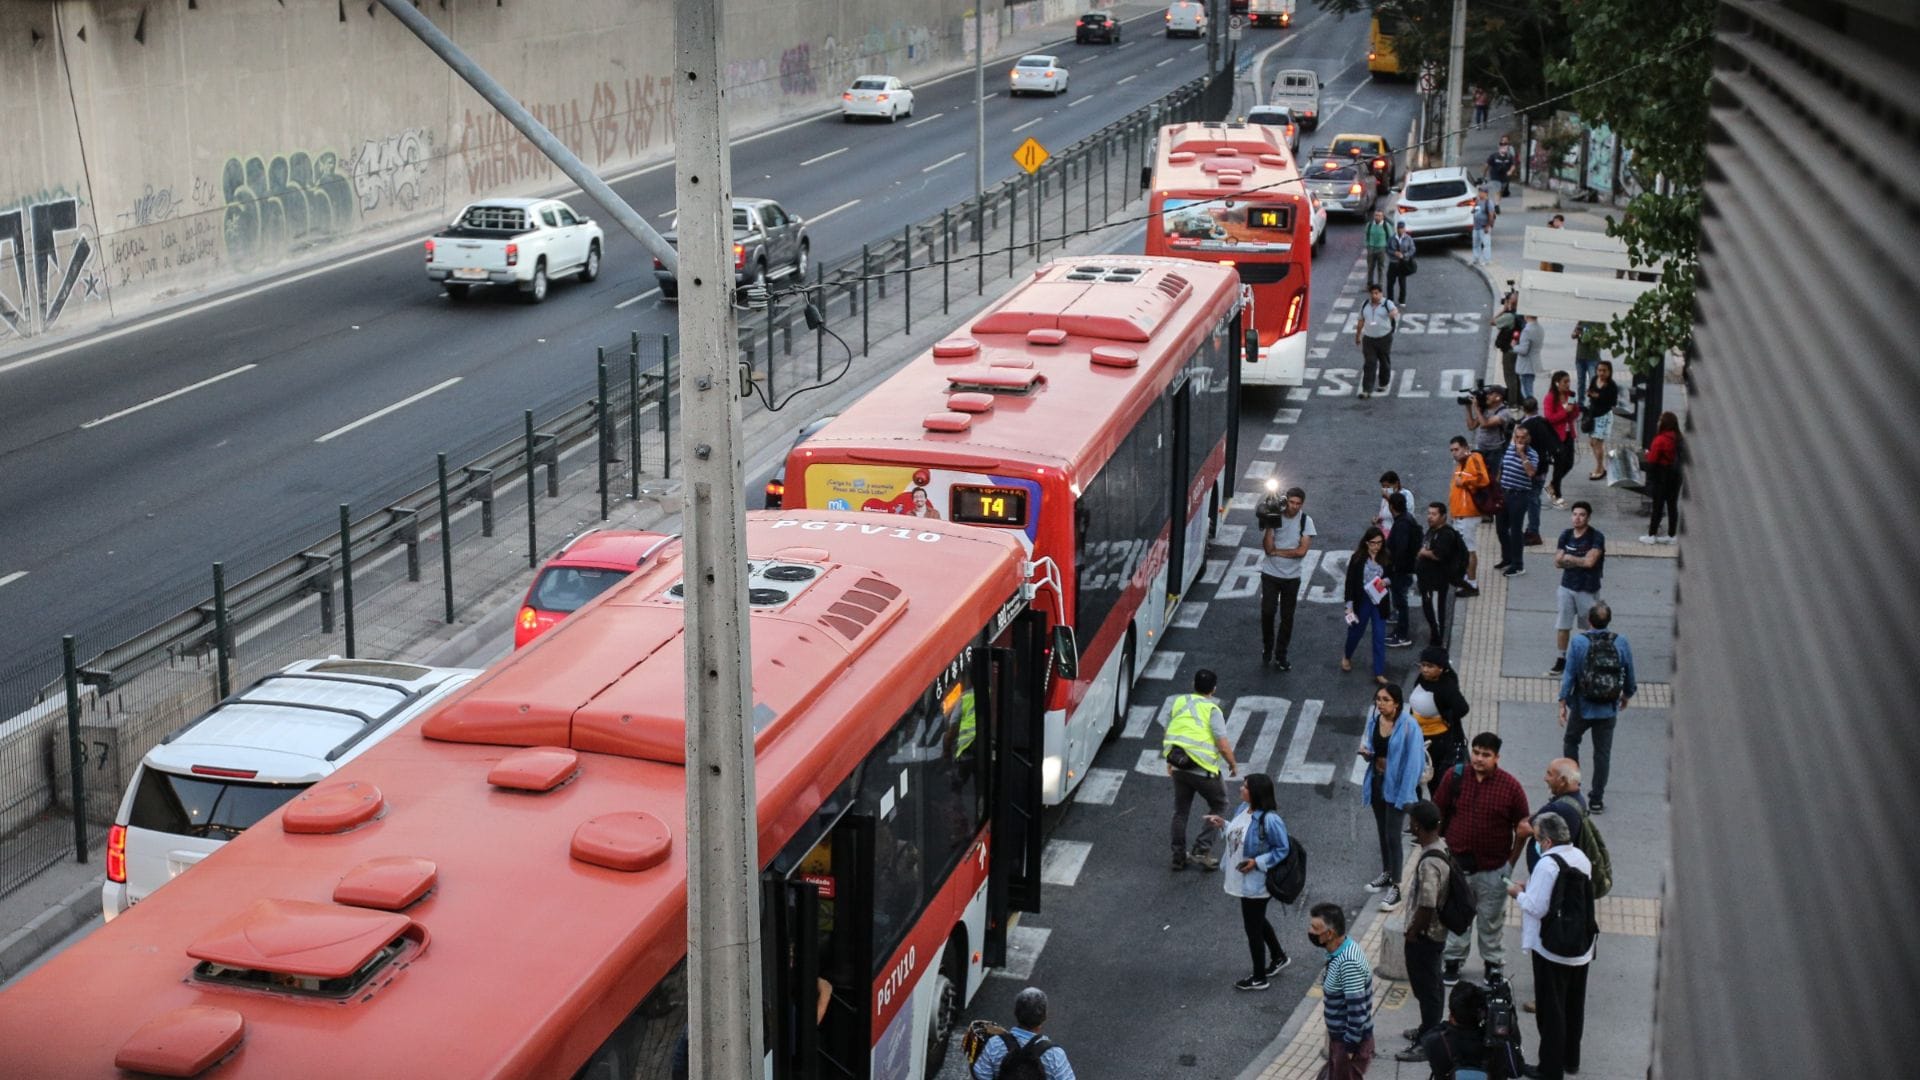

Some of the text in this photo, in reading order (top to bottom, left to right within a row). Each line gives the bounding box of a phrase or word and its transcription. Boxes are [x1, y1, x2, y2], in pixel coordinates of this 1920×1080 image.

[1262, 213, 1276, 225] T4
[1342, 312, 1482, 334] BSES
[981, 497, 1004, 517] T4
[771, 520, 941, 543] PGTV10
[1135, 695, 1368, 786] SOL
[877, 945, 916, 1016] PGTV10
